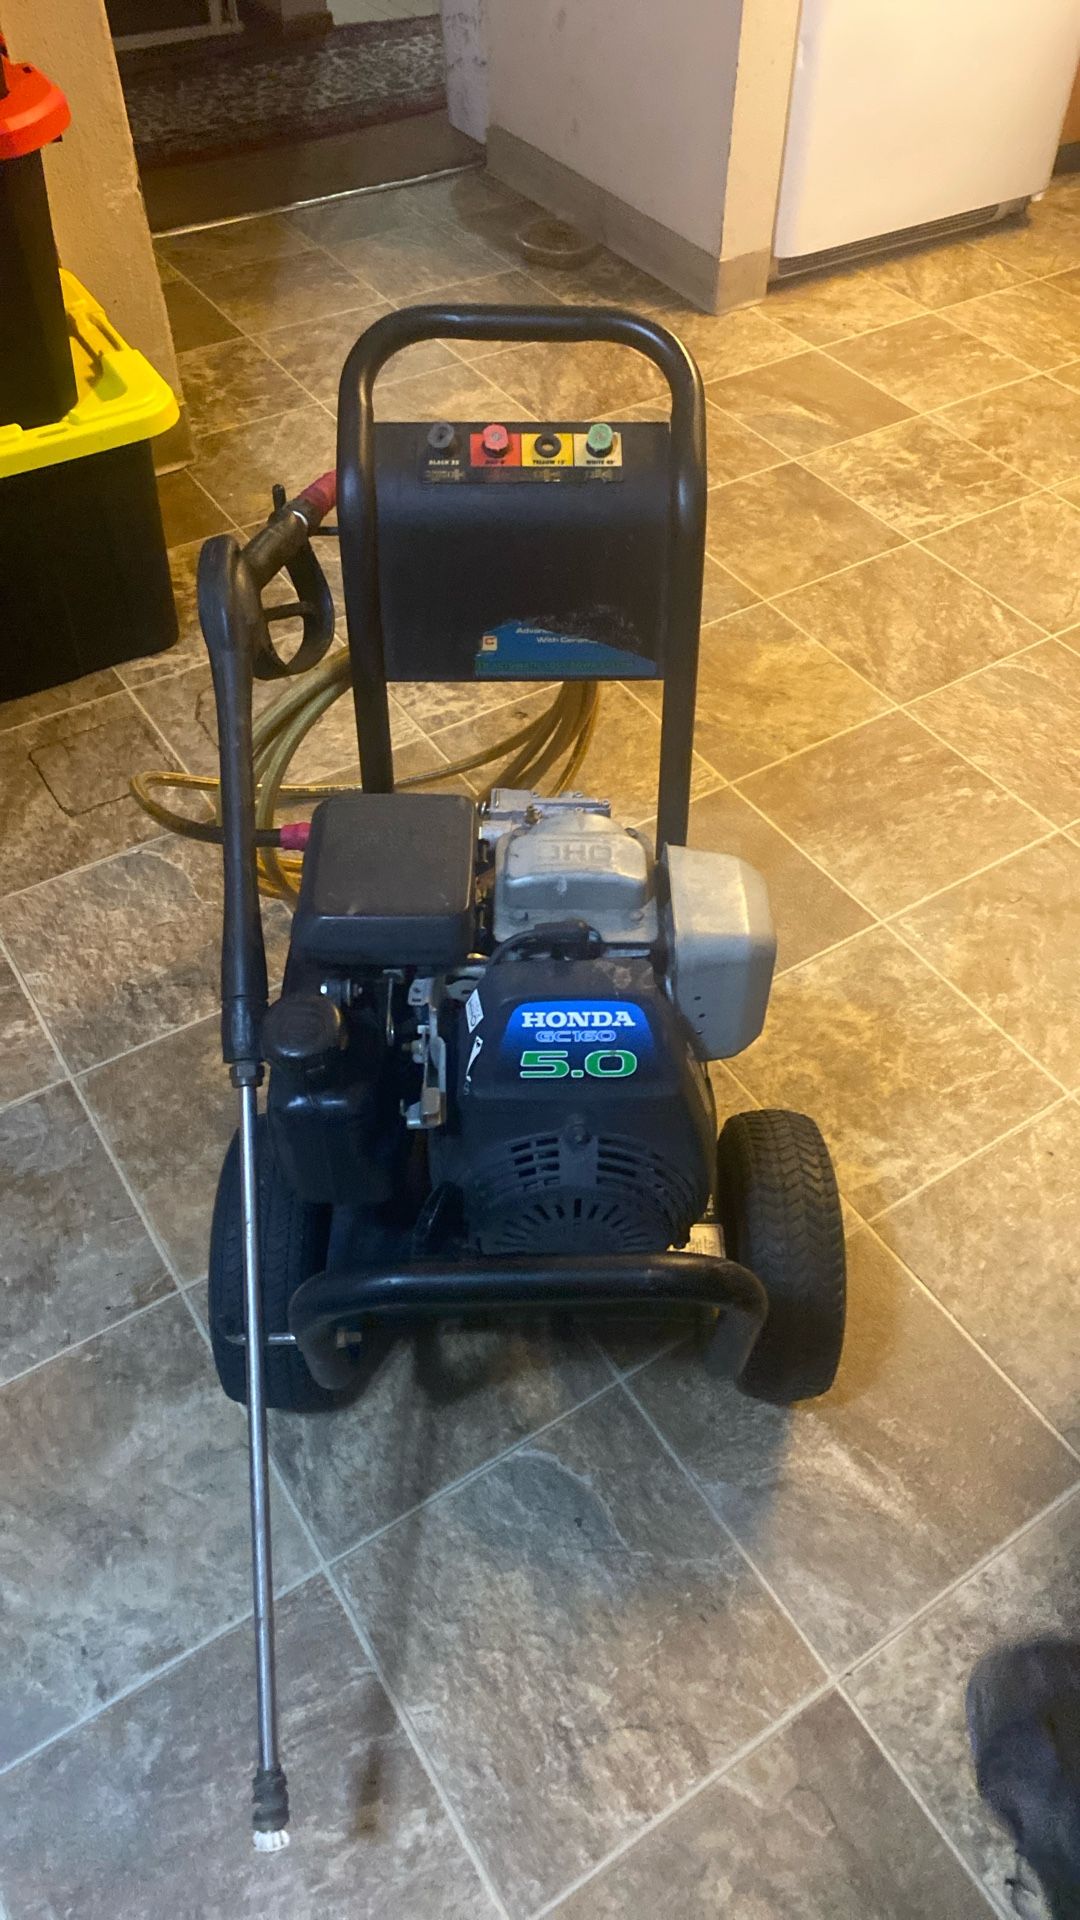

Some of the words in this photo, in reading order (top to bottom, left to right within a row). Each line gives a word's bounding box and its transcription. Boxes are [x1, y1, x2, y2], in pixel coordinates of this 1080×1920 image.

[521, 1011, 636, 1028] HONDA
[535, 1030, 616, 1043] GC160
[520, 1050, 637, 1078] 5.0
